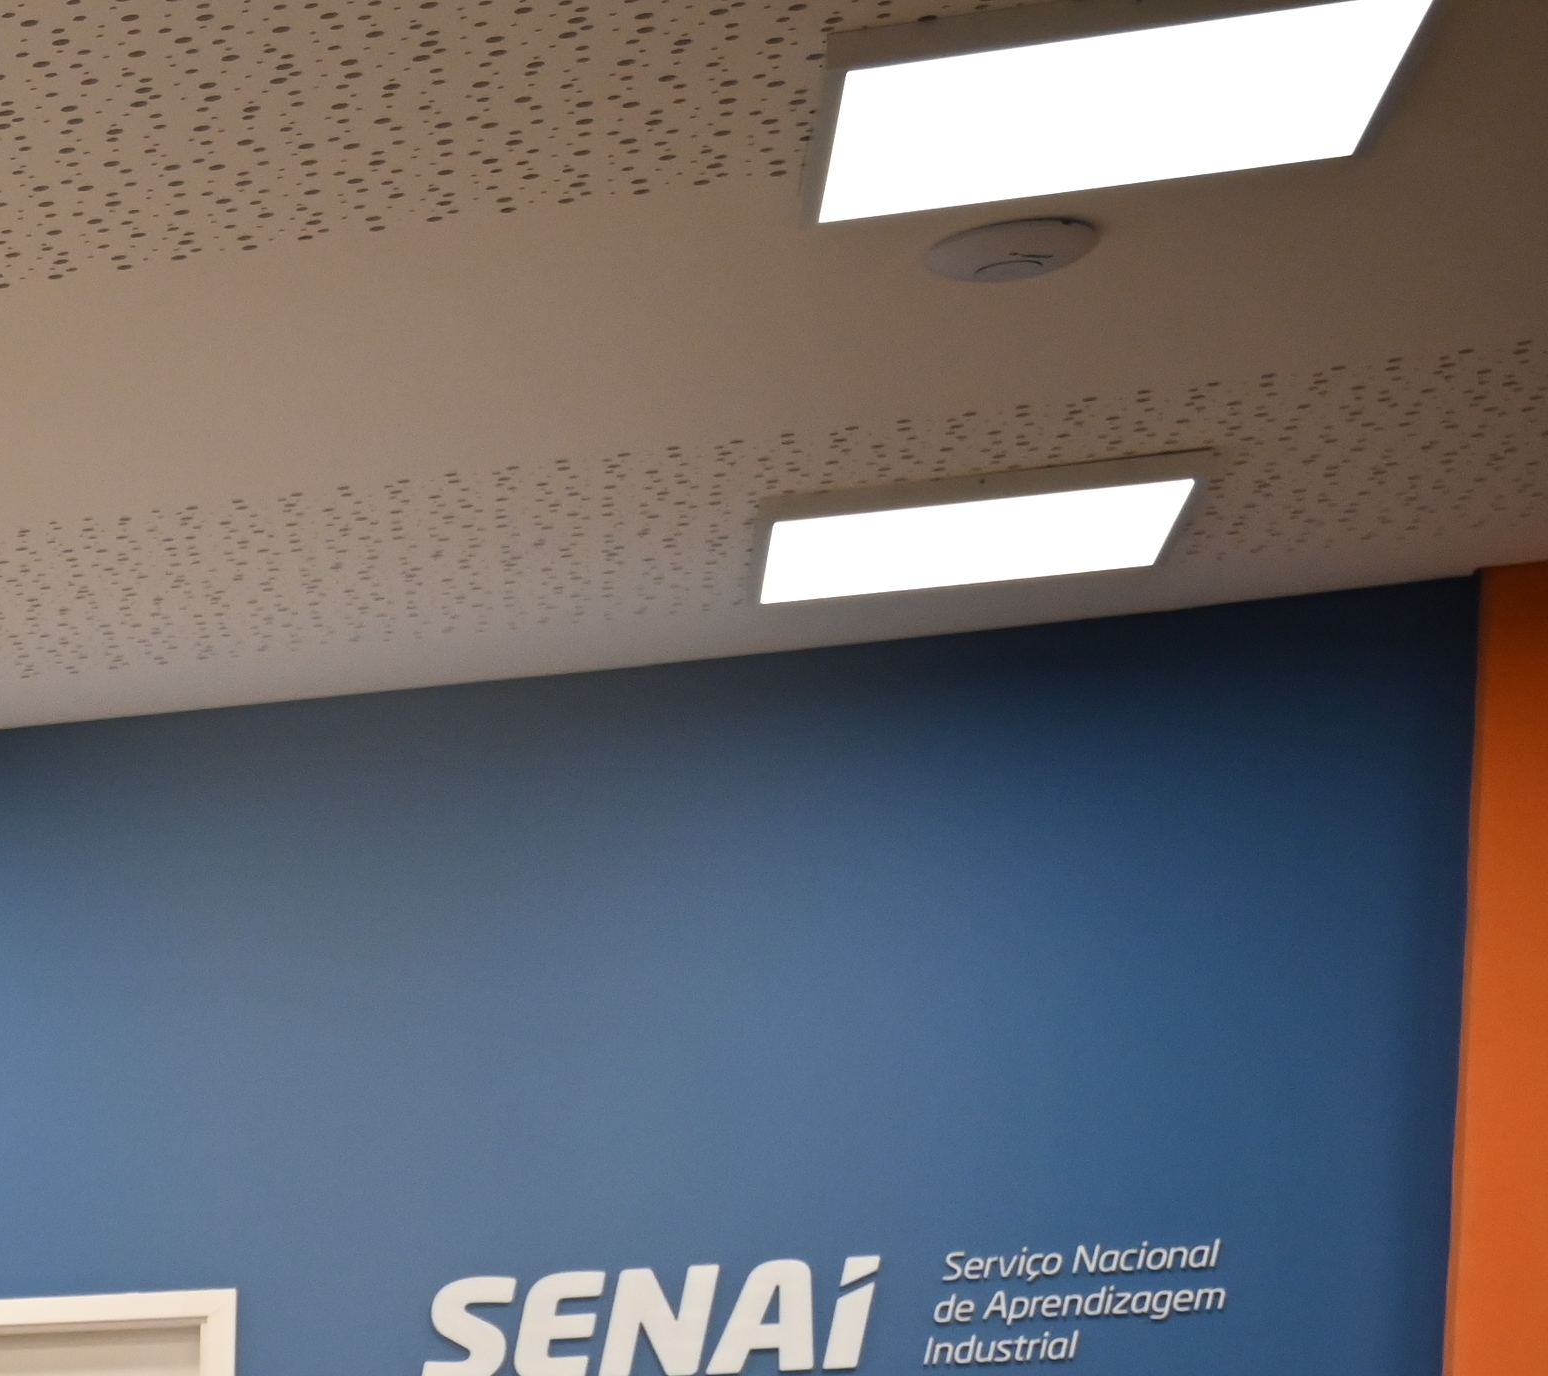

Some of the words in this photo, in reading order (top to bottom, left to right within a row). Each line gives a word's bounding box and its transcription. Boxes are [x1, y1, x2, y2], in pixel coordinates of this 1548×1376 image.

[942, 1246, 1063, 1282] Serviço
[1071, 1237, 1221, 1274] Nacional
[933, 1293, 975, 1323] de
[982, 1285, 1226, 1326] Aprendizagem
[922, 1329, 1079, 1366] Industrial
